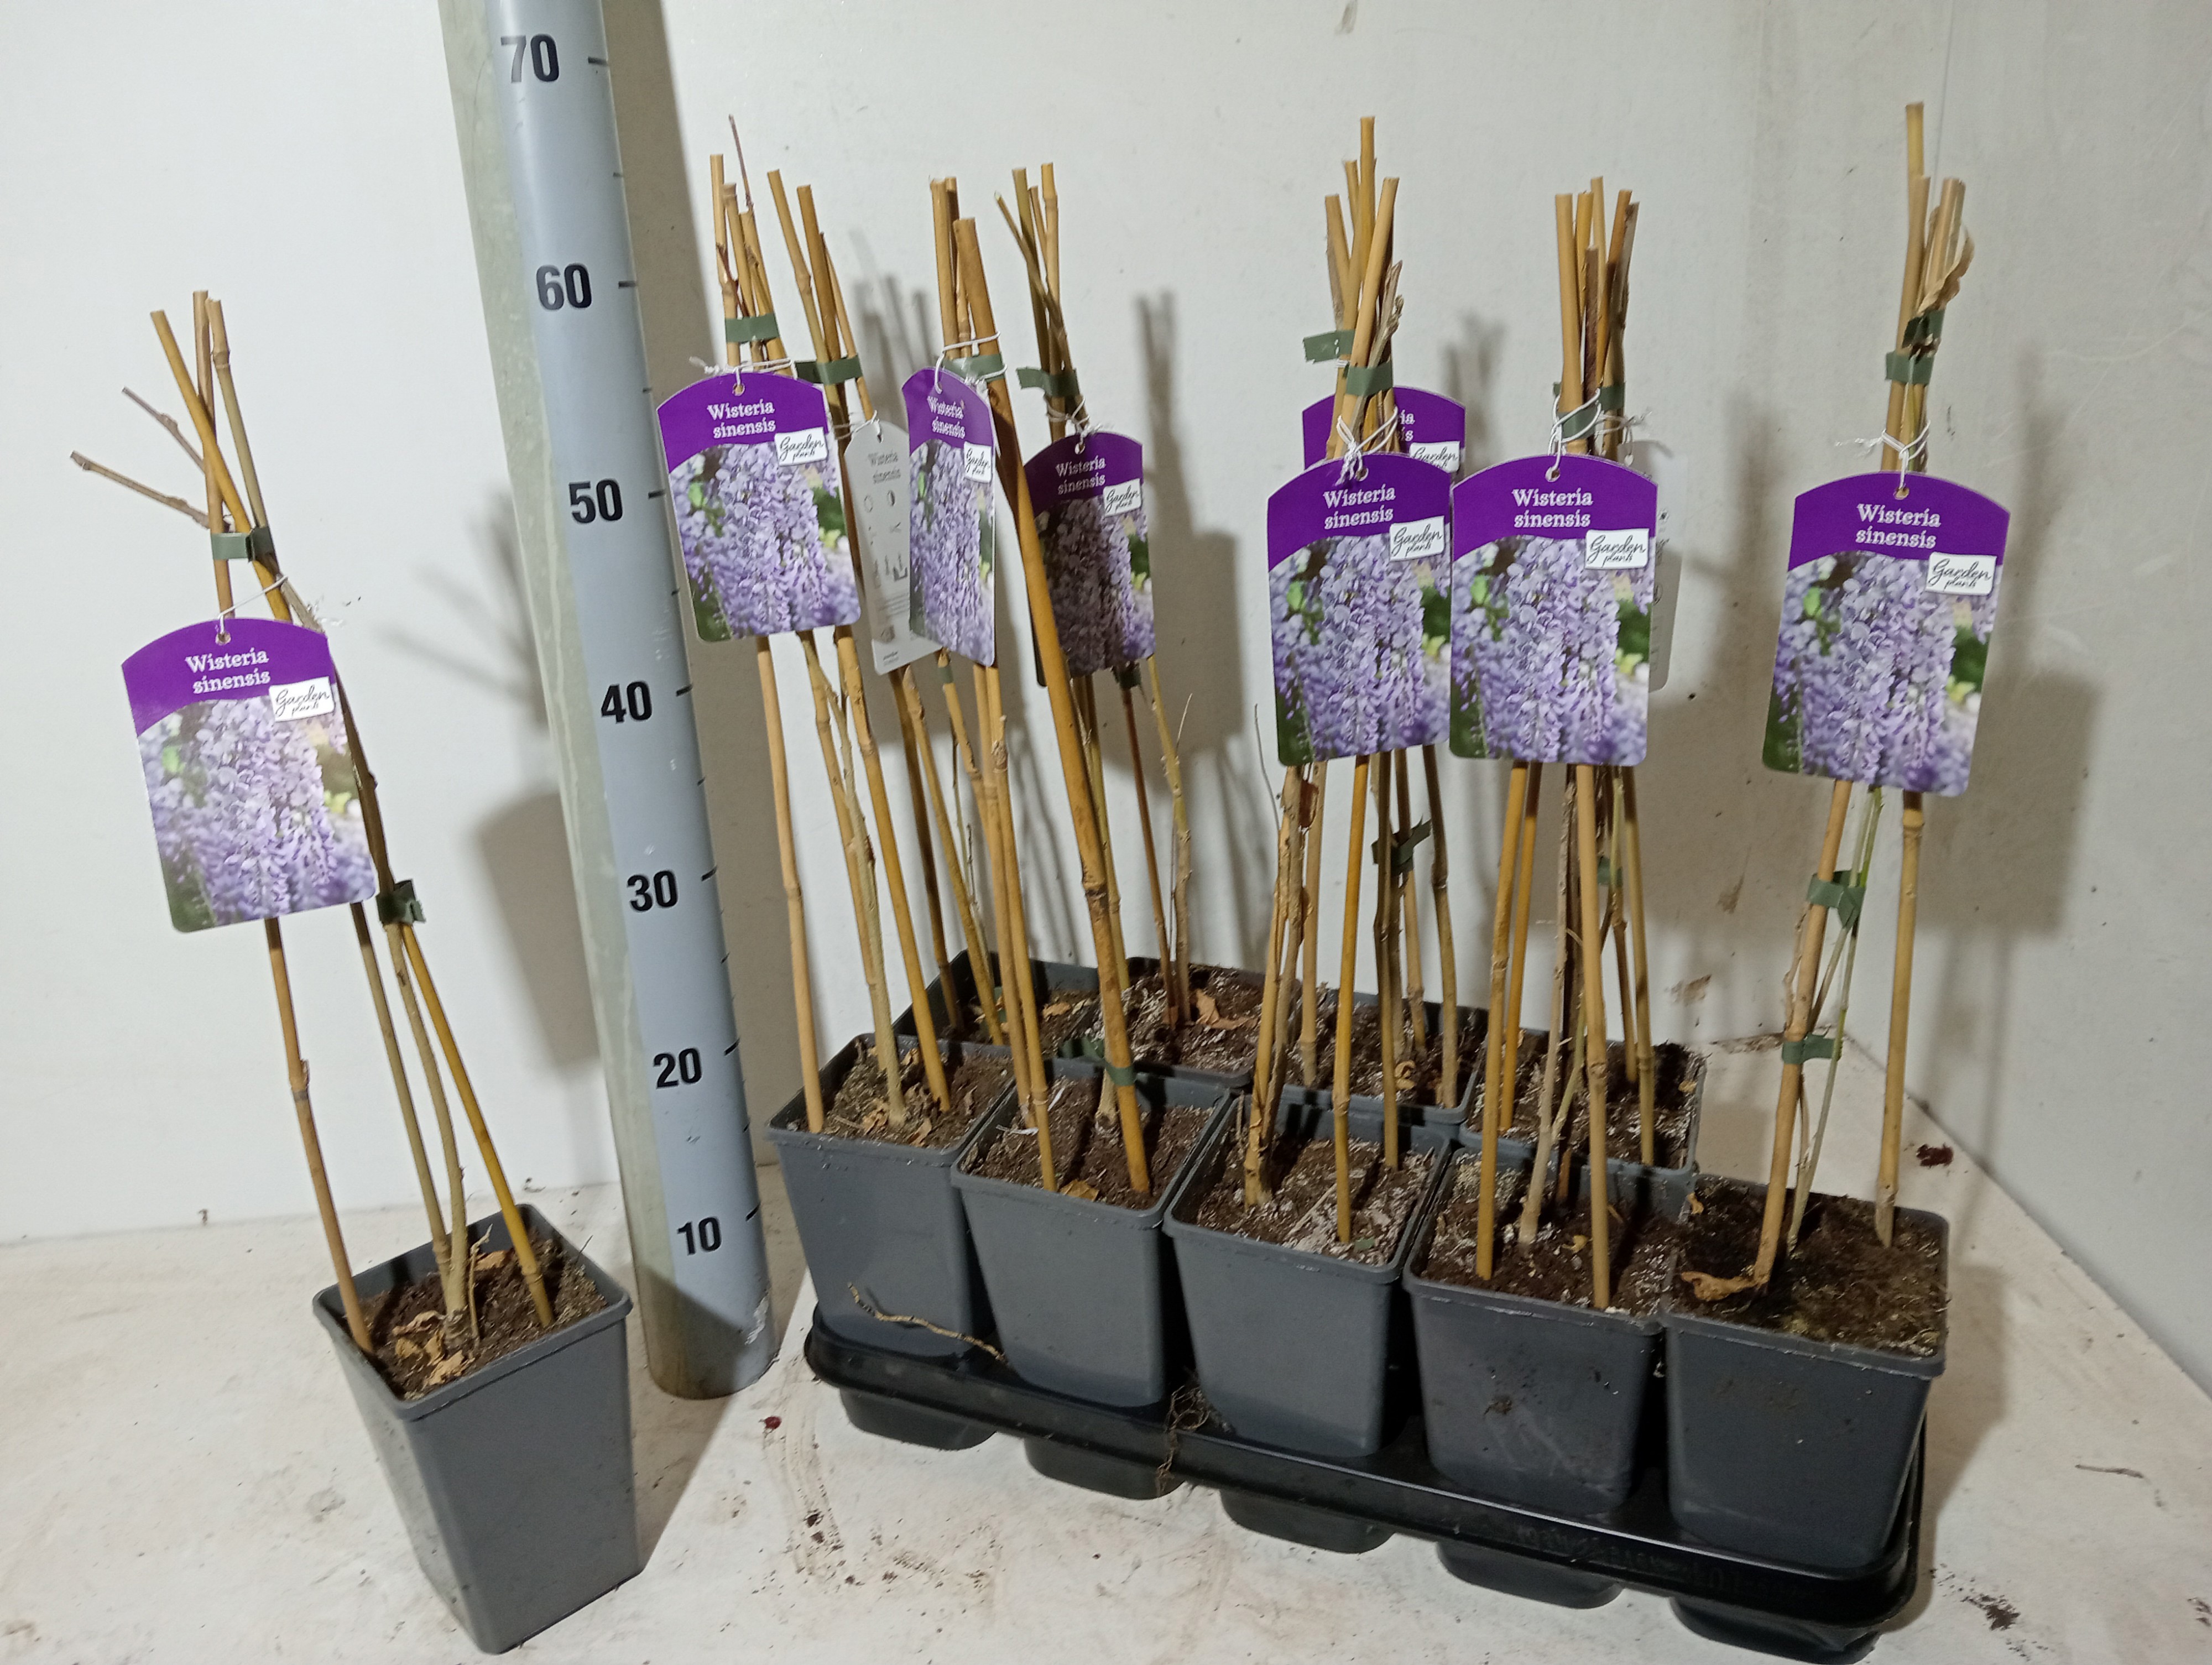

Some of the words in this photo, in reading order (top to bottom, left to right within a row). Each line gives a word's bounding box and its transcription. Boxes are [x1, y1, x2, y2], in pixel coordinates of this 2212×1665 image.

[500, 34, 560, 83] 70
[535, 263, 592, 311] 60
[707, 399, 775, 421] Wisteria
[713, 418, 776, 439] sinensis
[779, 434, 824, 461] Garden
[1055, 455, 1106, 477] Wisteria
[1057, 472, 1105, 495] sinensis
[1323, 483, 1396, 509] Wisteria
[568, 478, 623, 524] 50
[1511, 487, 1594, 507] Wisteria
[1324, 505, 1394, 530] sinensis
[1514, 509, 1591, 528] sinensis
[1856, 503, 1942, 528] Wisteria
[1391, 523, 1443, 556] Garden
[1587, 535, 1647, 562] Garden
[1855, 525, 1937, 549] sinensis
[1927, 559, 1992, 587] Garden
[185, 647, 269, 673] Wisteria
[192, 669, 271, 695] sinensis
[275, 685, 330, 717] Garden
[601, 680, 653, 724] 40
[627, 869, 679, 912] 30
[653, 1047, 703, 1089] 20
[677, 1217, 722, 1256] 10
